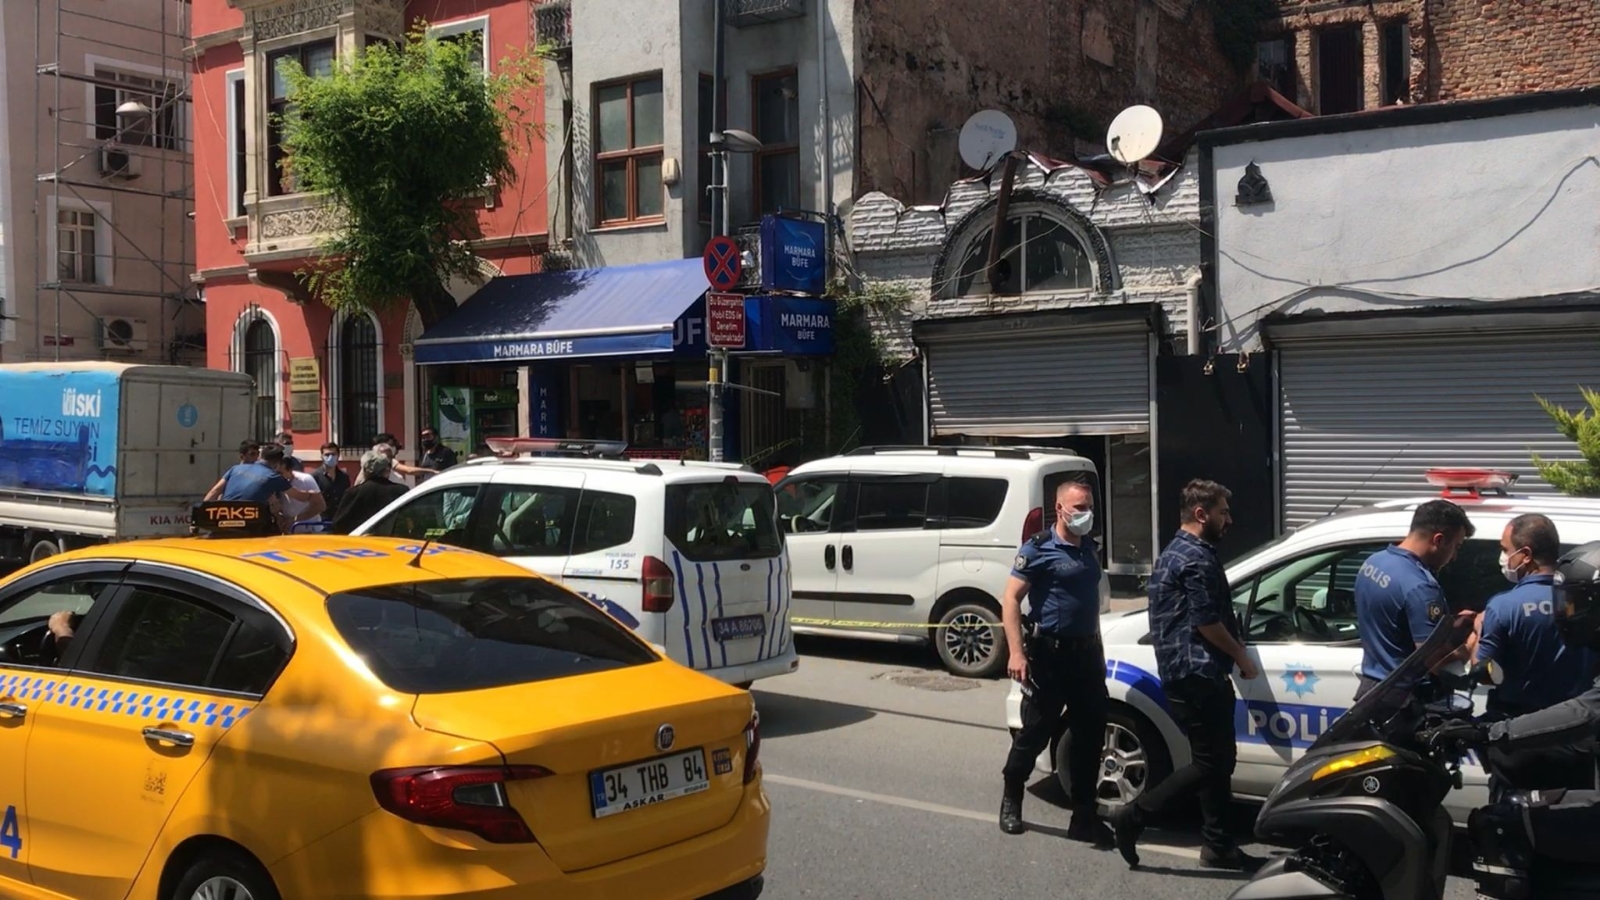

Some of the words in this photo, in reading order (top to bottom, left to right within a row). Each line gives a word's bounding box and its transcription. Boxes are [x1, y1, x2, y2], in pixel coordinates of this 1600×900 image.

[784, 245, 815, 258] MARMARA
[791, 257, 809, 268] BÜFE
[725, 310, 736, 319] EDS
[781, 314, 830, 329] MARMARA
[716, 321, 738, 331] Denetim
[797, 329, 816, 340] BÜFE
[493, 343, 544, 357] MARMARA
[546, 339, 573, 354] BÜFE
[14, 416, 51, 436] TEMİZ
[150, 516, 171, 525] KIA
[174, 515, 193, 524] MO
[609, 559, 629, 570] 155
[1522, 600, 1553, 617] PO
[731, 620, 738, 632] A
[1248, 708, 1339, 741] POLİ
[605, 772, 628, 802] 34
[637, 763, 669, 794] THB
[683, 755, 703, 782] 84
[623, 793, 664, 811] ASKAR
[0, 805, 22, 859] 4
